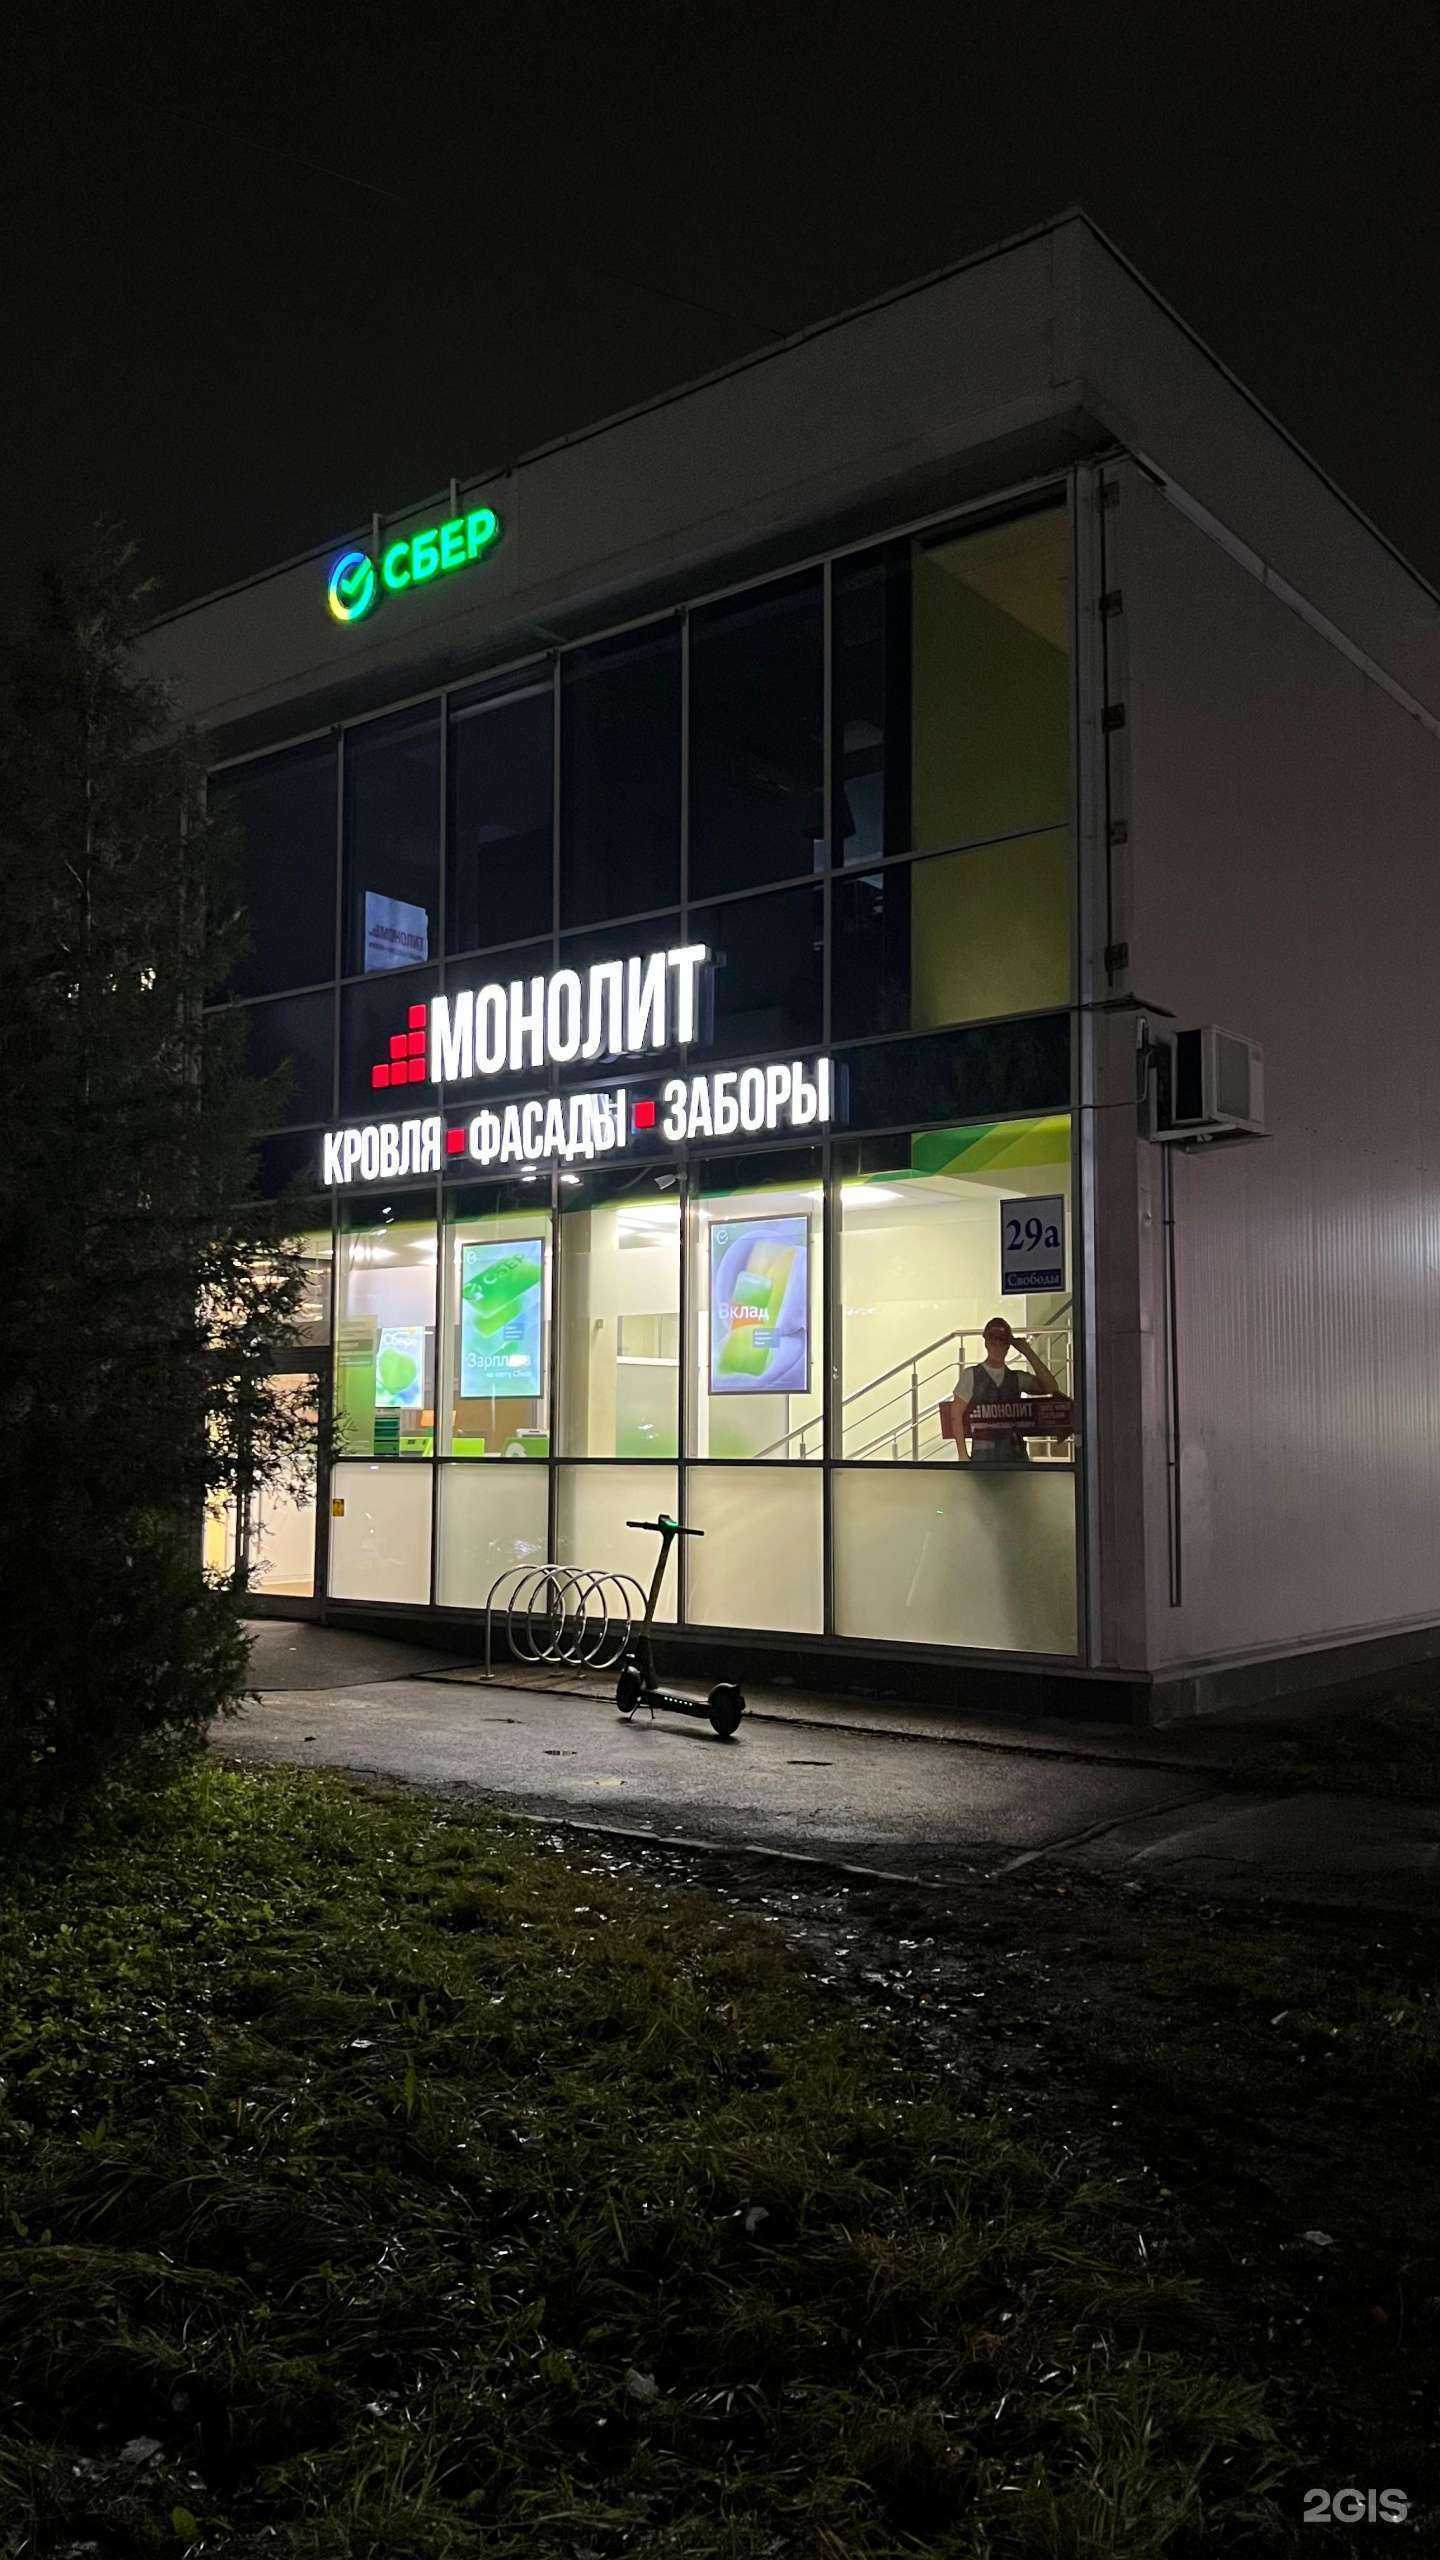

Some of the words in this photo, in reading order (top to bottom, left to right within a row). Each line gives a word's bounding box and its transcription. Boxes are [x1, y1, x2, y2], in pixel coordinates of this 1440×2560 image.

[382, 507, 499, 589] СБЕР
[430, 943, 706, 1083] МОНОЛИТ
[322, 1115, 442, 1185] КРОВЛЯ
[469, 1088, 626, 1166] ФАСАДЫ
[663, 1057, 830, 1141] ЗАБОРЫ
[1006, 1217, 1060, 1252] 29а
[1007, 1271, 1060, 1287] Свободы
[718, 1302, 770, 1321] Вклад
[467, 1352, 531, 1371] Зарпла
[981, 1403, 1033, 1419] МОНОЛИТ
